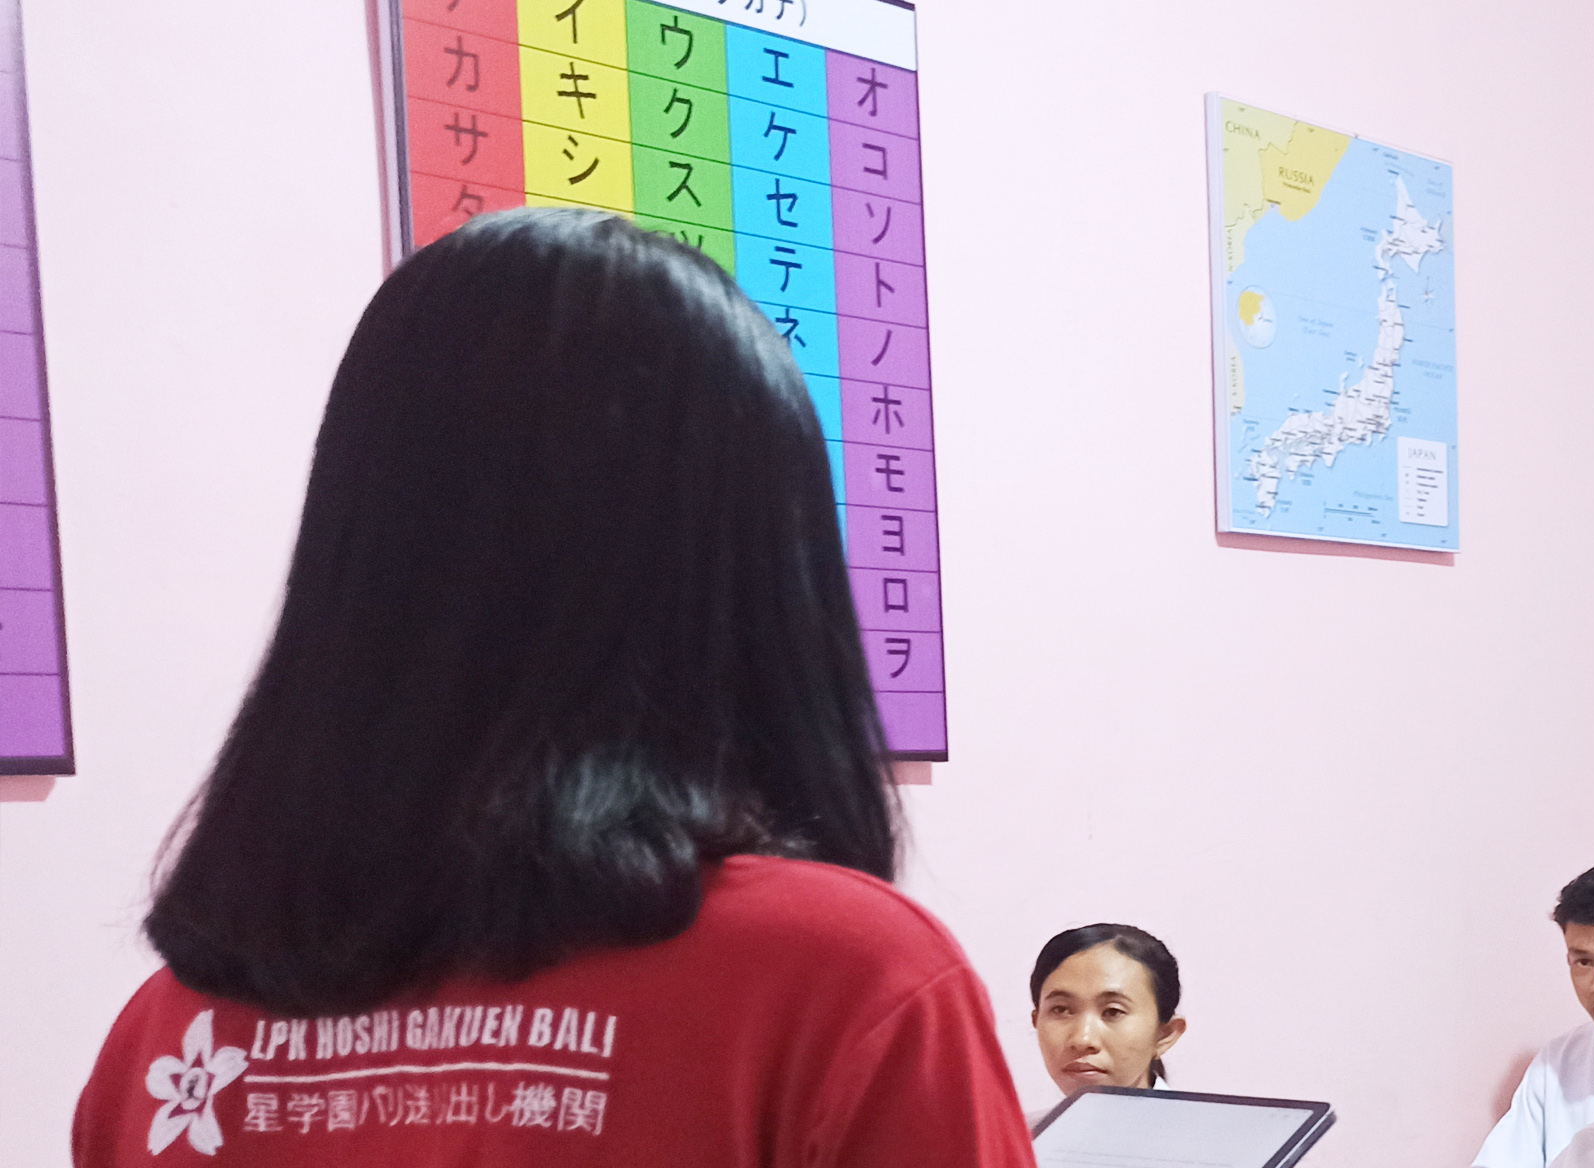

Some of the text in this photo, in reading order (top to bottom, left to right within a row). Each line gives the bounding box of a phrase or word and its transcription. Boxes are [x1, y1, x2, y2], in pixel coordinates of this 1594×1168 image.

[555, 0, 889, 117] イ ウ エ オ
[444, 35, 889, 180] カ キ ク ケ コ
[1225, 120, 1260, 141] CHINA
[444, 111, 892, 245] サ シ ス セ ソ
[1278, 166, 1315, 186] RUSSIA
[769, 246, 803, 293] テ
[874, 261, 896, 308] ト
[870, 329, 893, 367] ノ
[871, 384, 905, 435] ホ
[875, 454, 905, 493] モ
[880, 515, 905, 556] ヨ
[884, 637, 911, 679] ヲ
[251, 1004, 617, 1061] LPK HOSHI GAKUEN BALI
